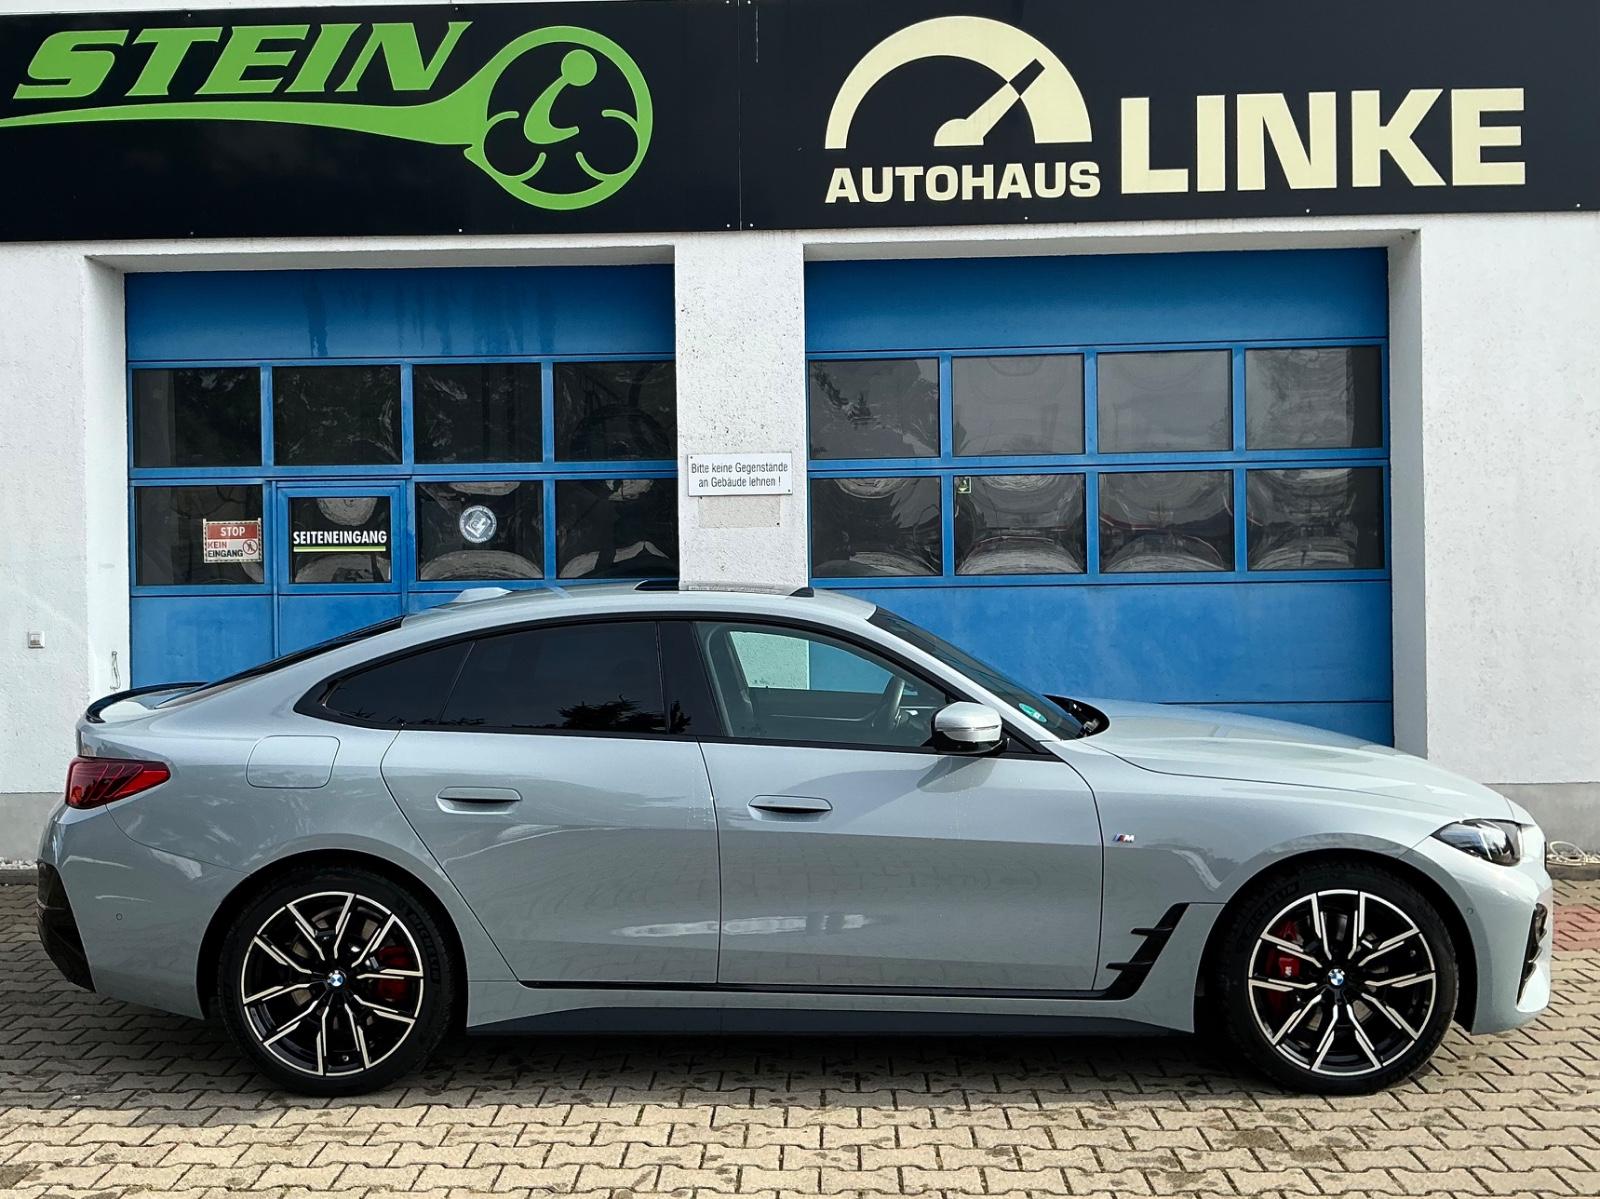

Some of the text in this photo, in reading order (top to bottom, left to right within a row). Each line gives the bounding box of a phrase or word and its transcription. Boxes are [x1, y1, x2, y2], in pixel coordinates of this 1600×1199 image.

[13, 21, 472, 100] STEIN
[1120, 87, 1526, 195] LINKE
[825, 160, 1101, 204] AUTOHAUS
[691, 462, 789, 475] Bitte keine Gegenstände
[698, 478, 709, 488] an
[711, 476, 747, 488] Gebäude
[748, 476, 776, 487] lehnen
[220, 526, 246, 537] STOP
[293, 530, 387, 545] SEITENEINGANG
[207, 541, 228, 549] KEIN
[207, 549, 244, 558] EINGANG
